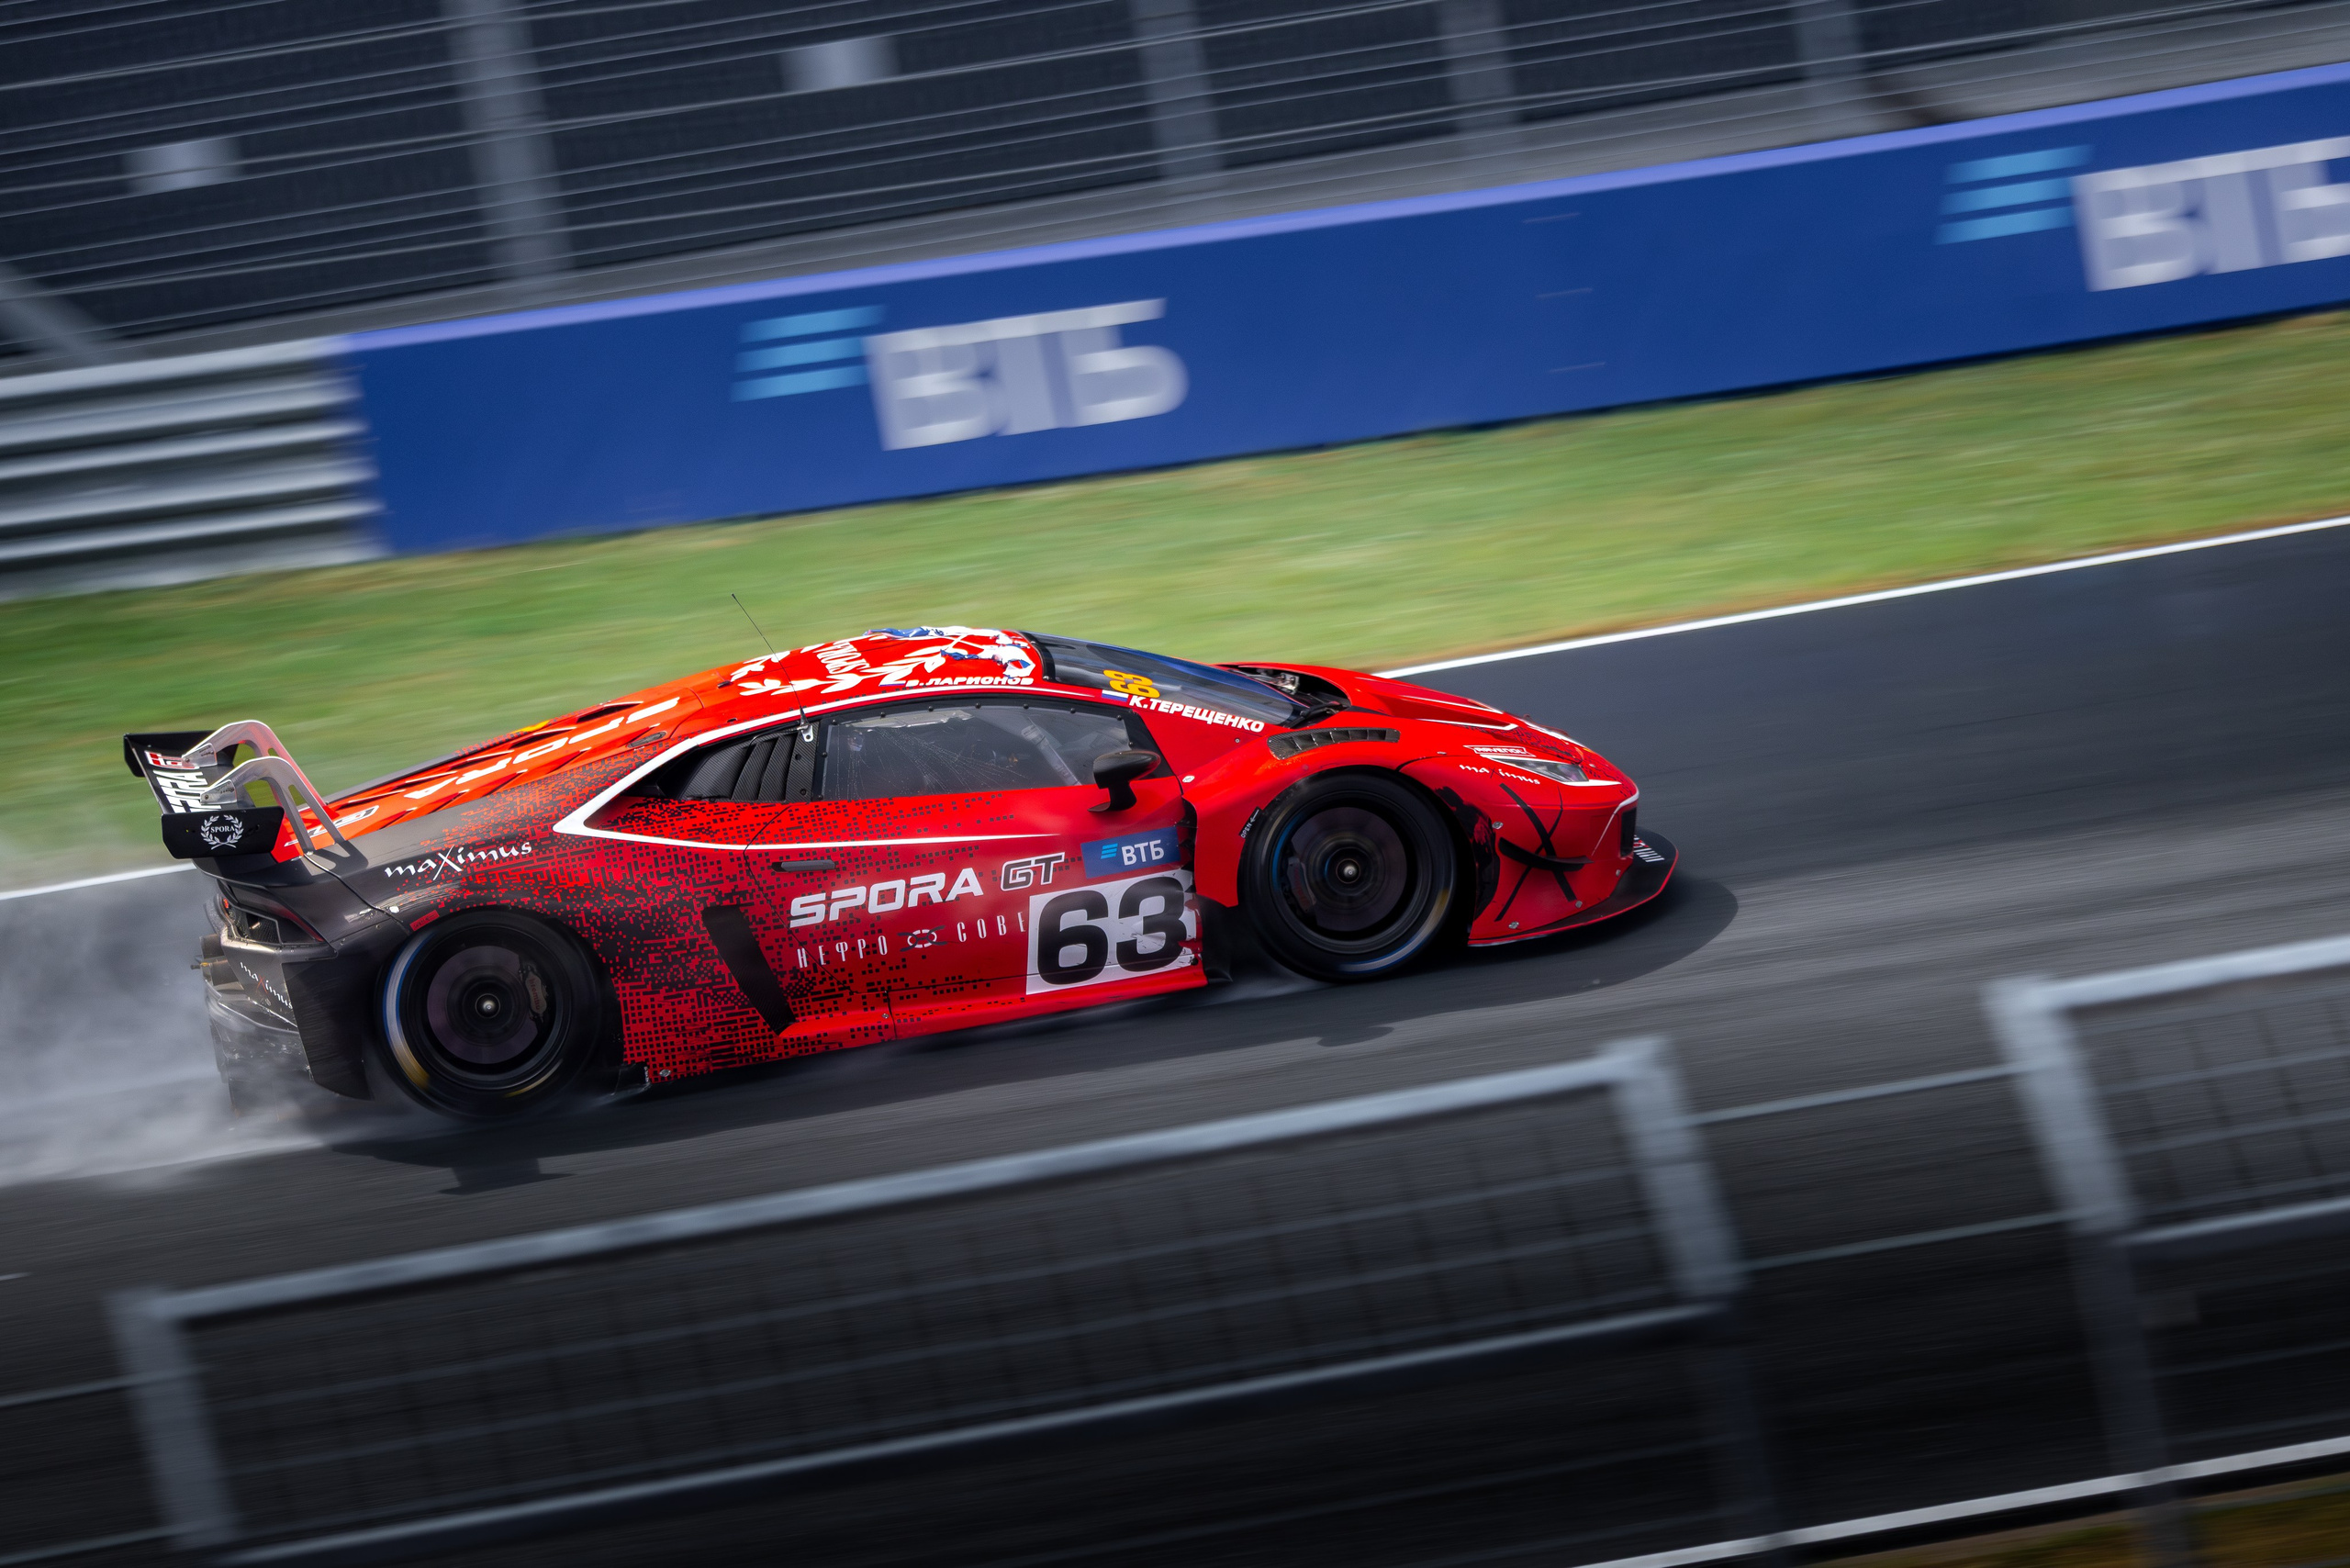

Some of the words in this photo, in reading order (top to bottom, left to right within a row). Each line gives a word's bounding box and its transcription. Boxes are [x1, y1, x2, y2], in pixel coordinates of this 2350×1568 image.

[861, 297, 1189, 451] ВТБ
[1129, 696, 1265, 733] К.ТЕРЕЩЕНКО
[210, 825, 235, 834] SPORA
[1240, 823, 1253, 839] OPEN
[1121, 839, 1165, 866] ВТБ
[789, 867, 984, 928] SPORA
[1000, 852, 1065, 891] GT
[1037, 876, 1187, 985] 63
[797, 935, 888, 969] НЕФРО
